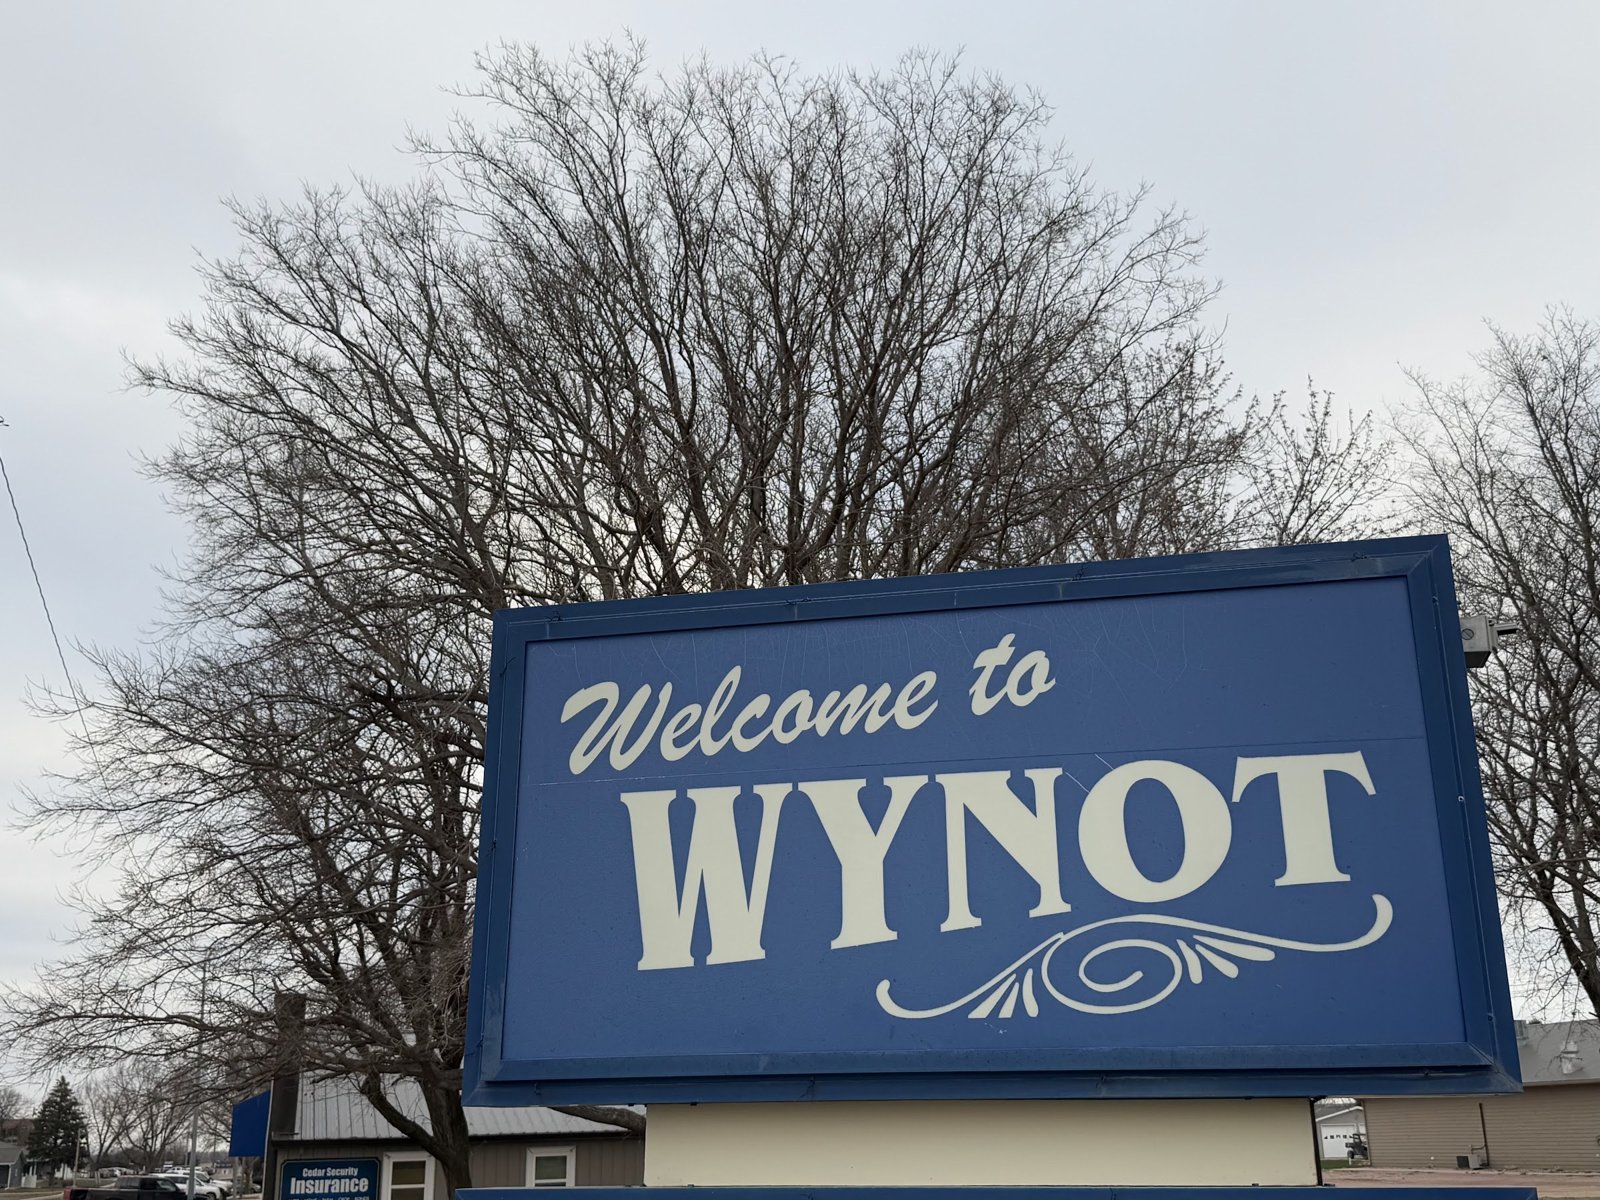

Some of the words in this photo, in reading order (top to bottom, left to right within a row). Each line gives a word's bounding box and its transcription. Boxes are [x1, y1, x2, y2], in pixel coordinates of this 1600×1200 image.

[561, 666, 937, 774] Welcome
[970, 634, 1055, 715] to
[621, 752, 1376, 971] WYNOT
[290, 1177, 369, 1194] Insurance
[302, 1168, 325, 1177] Cedar
[326, 1167, 358, 1177] Security
